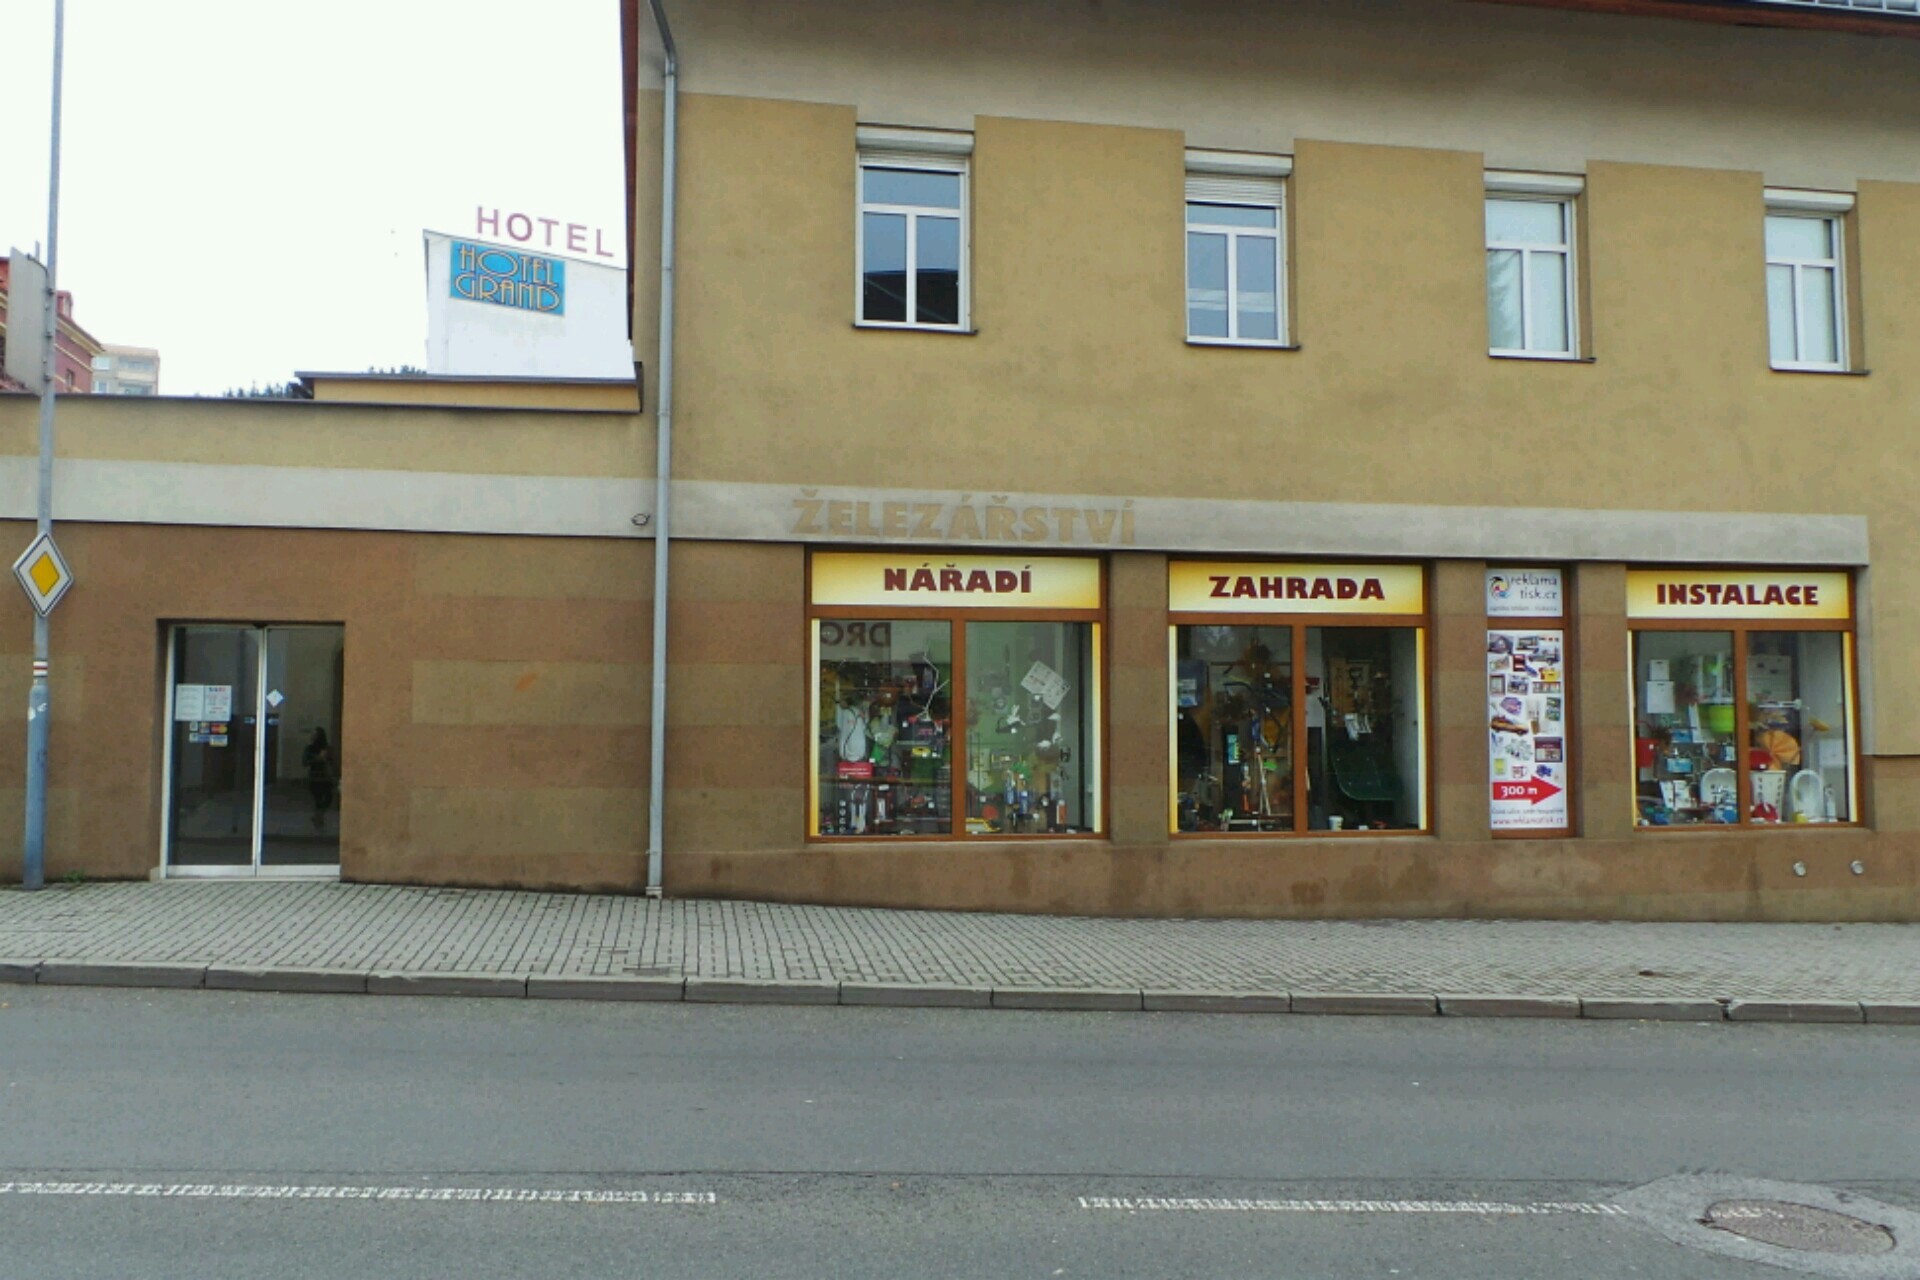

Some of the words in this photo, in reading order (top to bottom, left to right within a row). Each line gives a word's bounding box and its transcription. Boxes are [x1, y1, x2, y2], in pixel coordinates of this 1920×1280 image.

[477, 206, 614, 258] HOTEL
[458, 243, 558, 287] HOTEL
[454, 271, 562, 312] GRAND
[789, 489, 1136, 545] ŽELEZÁŘSTVÍ
[884, 562, 1032, 593] NÁŘADÍ
[1209, 576, 1385, 600] ZAHRADA
[1510, 573, 1557, 586] reklama
[1657, 584, 1819, 605] INSTALACE
[1501, 786, 1525, 798] 300
